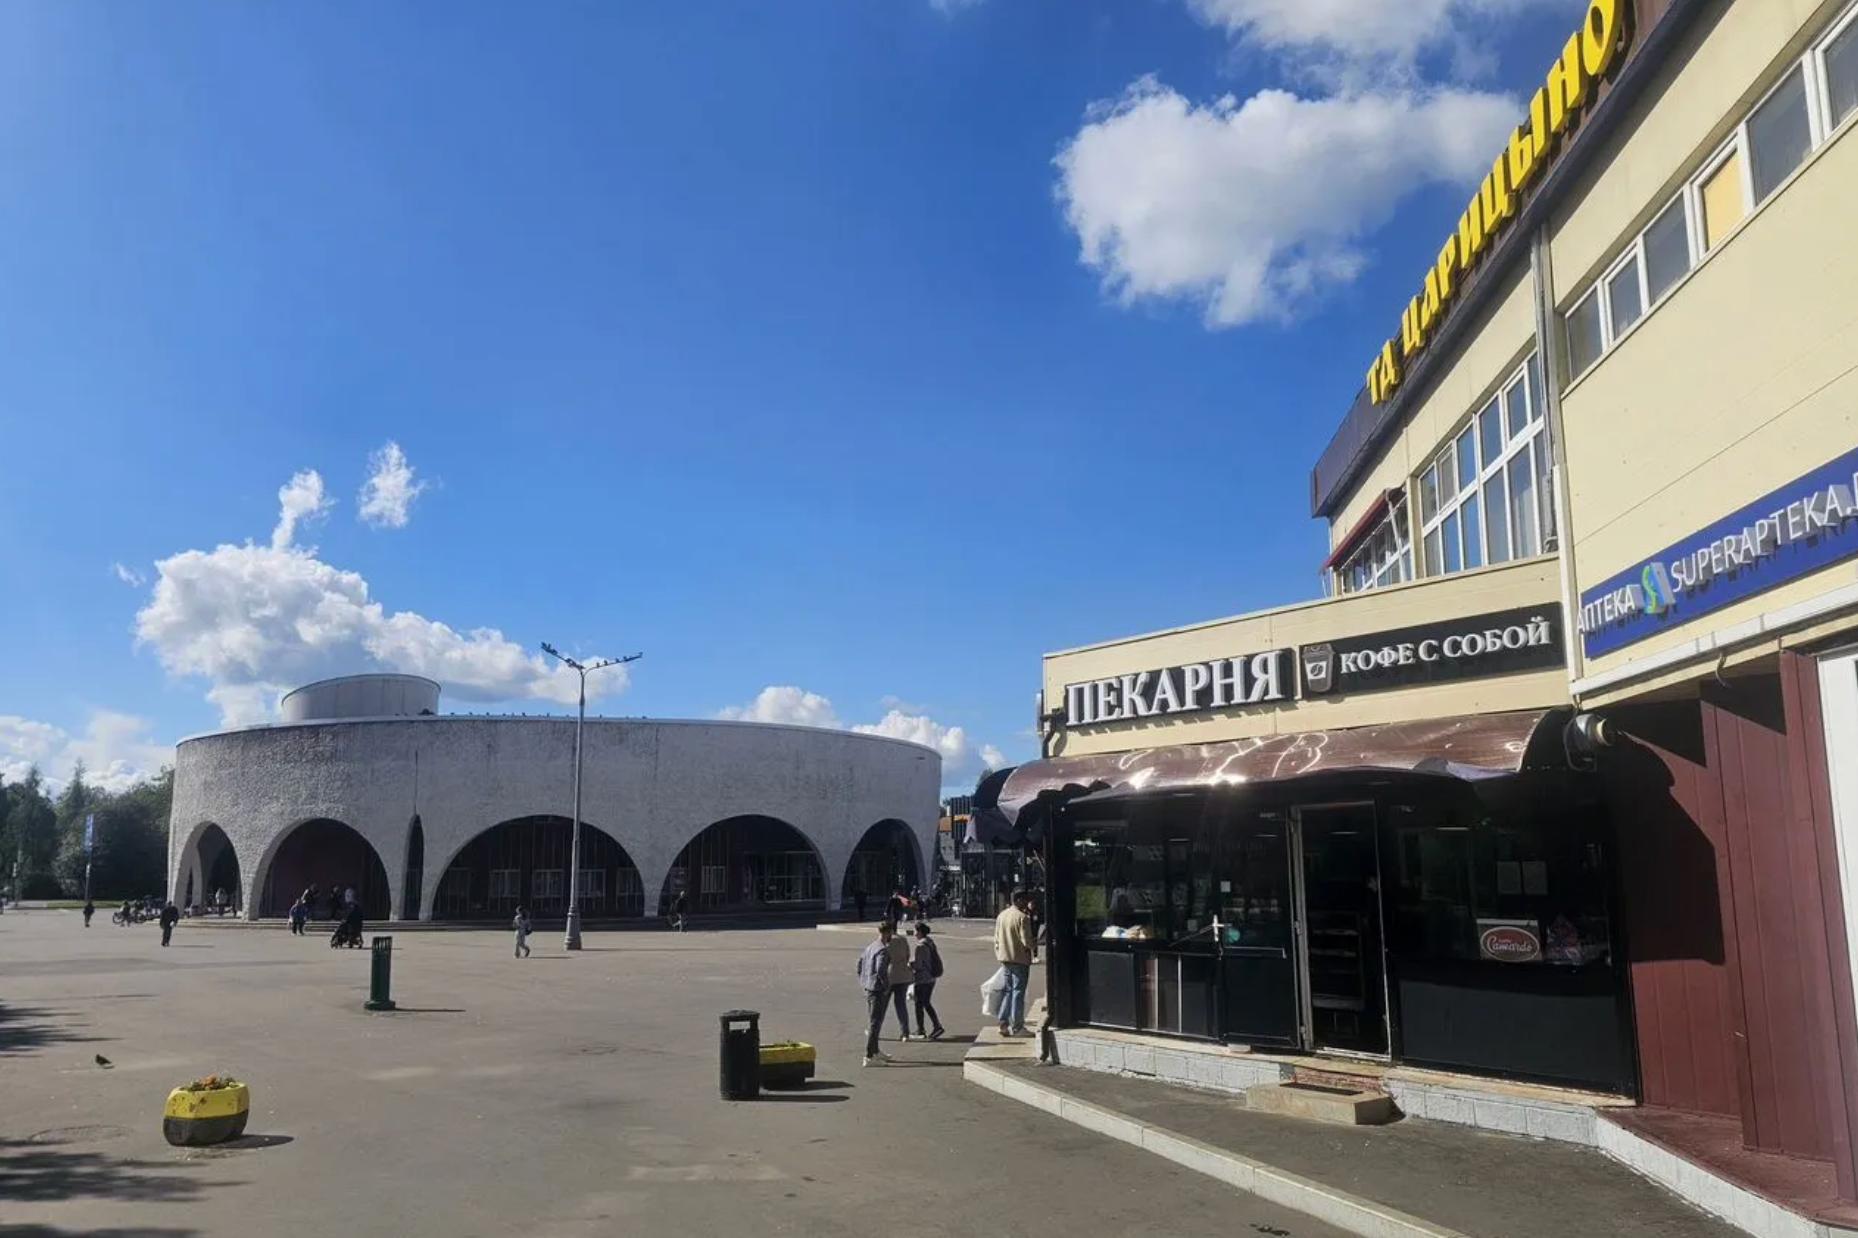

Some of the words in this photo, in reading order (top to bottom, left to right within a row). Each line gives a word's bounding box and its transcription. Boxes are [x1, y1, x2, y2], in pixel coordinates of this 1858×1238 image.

[1402, 0, 1618, 356] ЦАРИЦЫНО
[1671, 472, 1858, 592] SUPERAPTEKA.
[1340, 642, 1414, 674] КОФЕ
[1419, 639, 1440, 661] С
[1443, 615, 1551, 658] СОБОЙ
[1577, 585, 1636, 634] АПТЕКА
[1066, 650, 1284, 726] ПЕКАРНЯ
